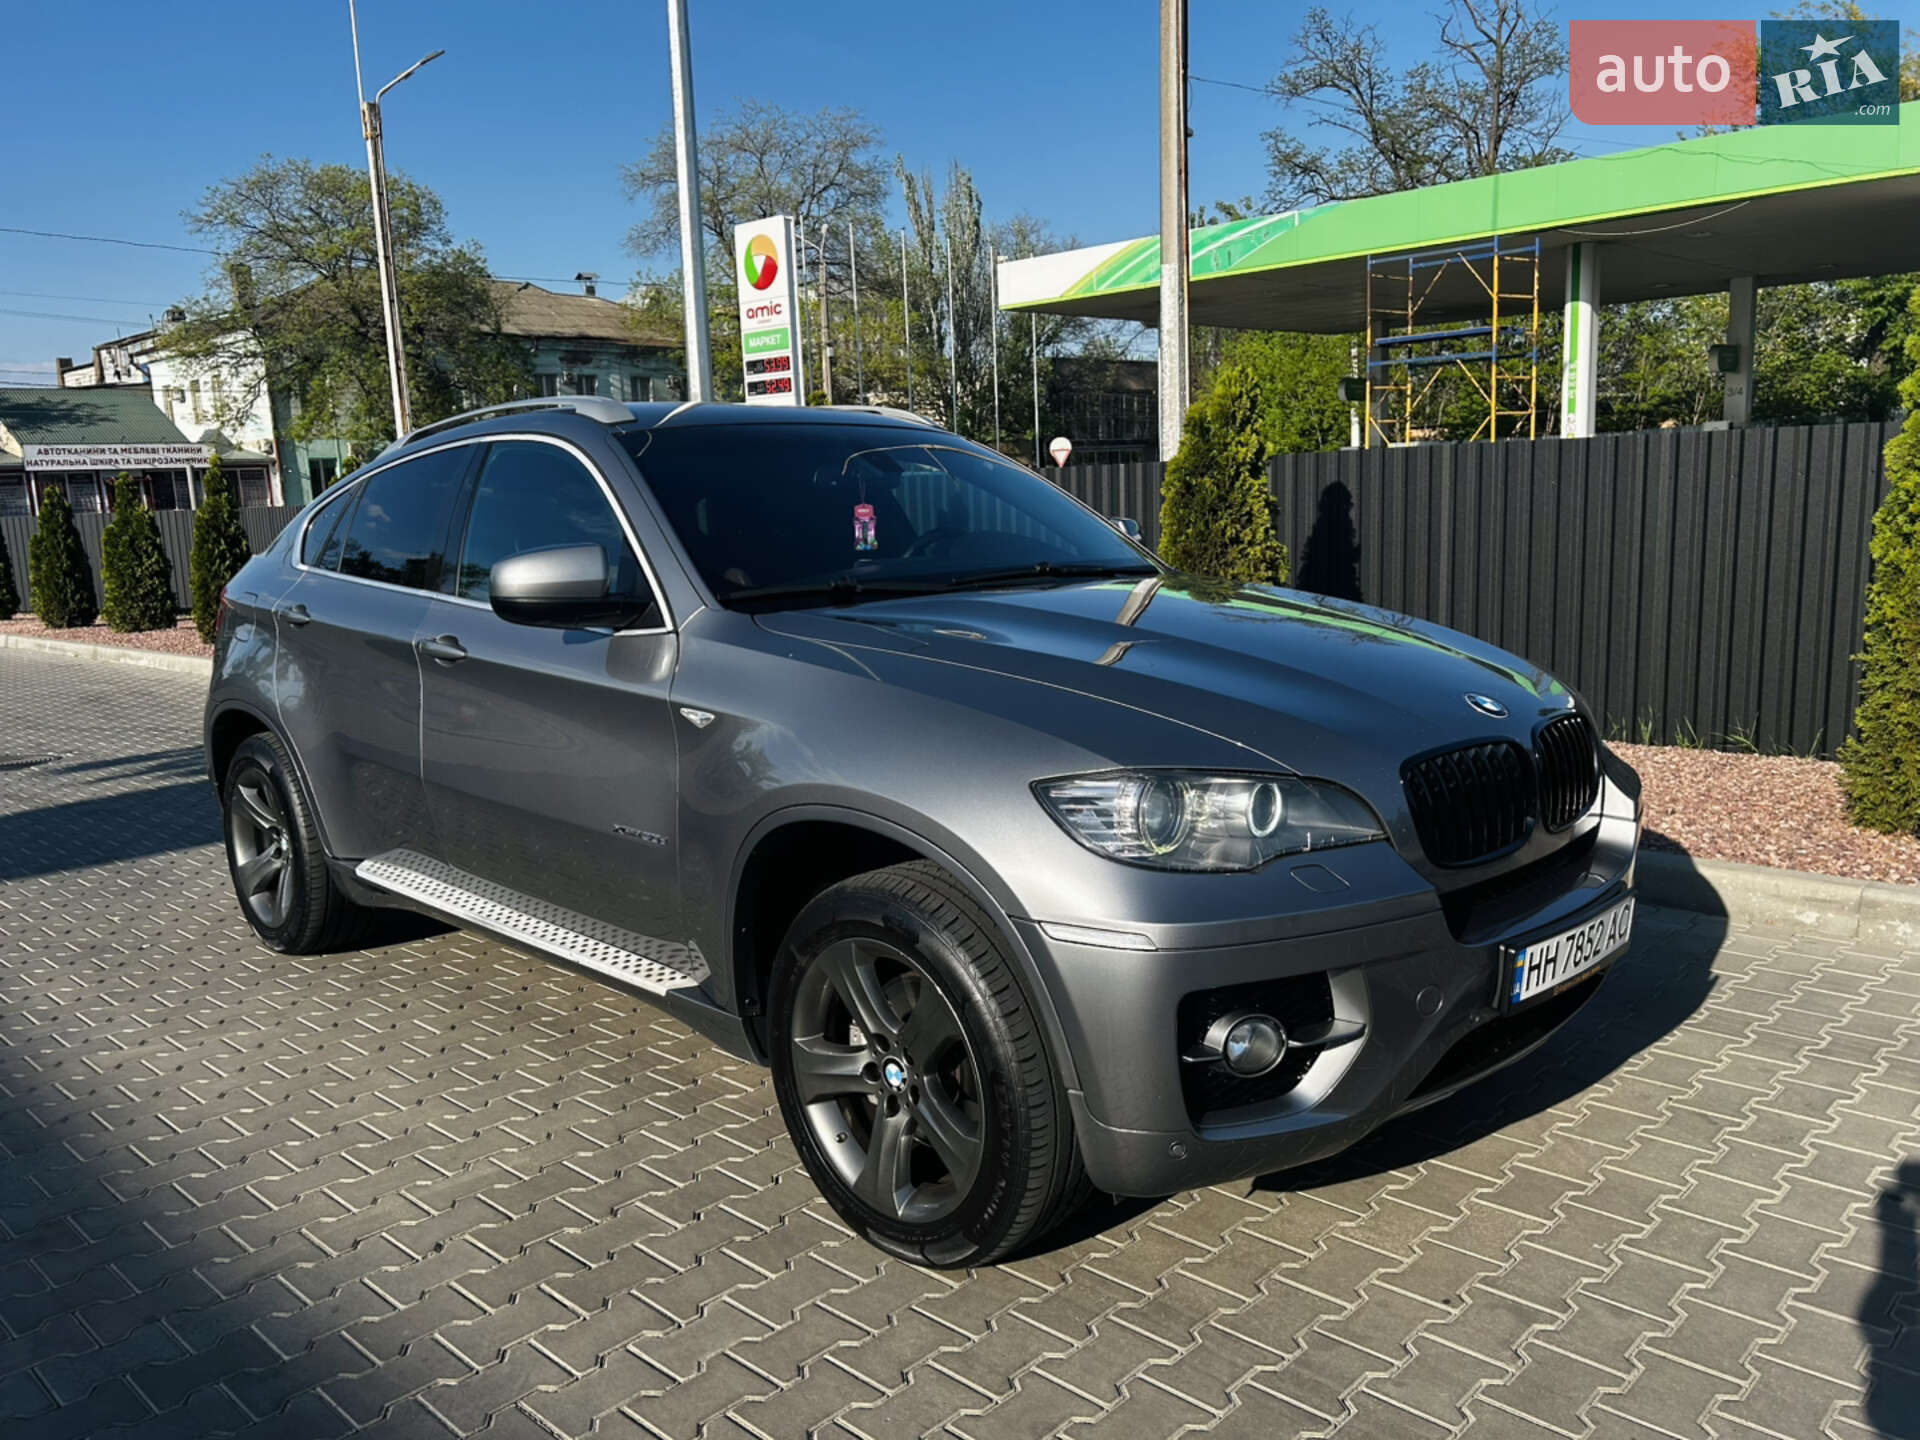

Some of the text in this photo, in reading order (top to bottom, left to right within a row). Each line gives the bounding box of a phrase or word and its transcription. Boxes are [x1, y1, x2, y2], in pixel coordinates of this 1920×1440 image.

[746, 300, 782, 320] amic
[749, 334, 782, 348] МАРКЕТ
[36, 447, 106, 456] АВТОТКАНИНИ
[107, 447, 119, 455] ТА
[162, 446, 202, 455] ТКАНИНИ
[26, 458, 88, 467] НАТУРАЛЬНА
[90, 458, 120, 466] ШКІРА
[121, 457, 133, 465] ТА
[1525, 941, 1560, 992] HH
[1561, 919, 1604, 974] 7852
[1604, 903, 1630, 949] AC
